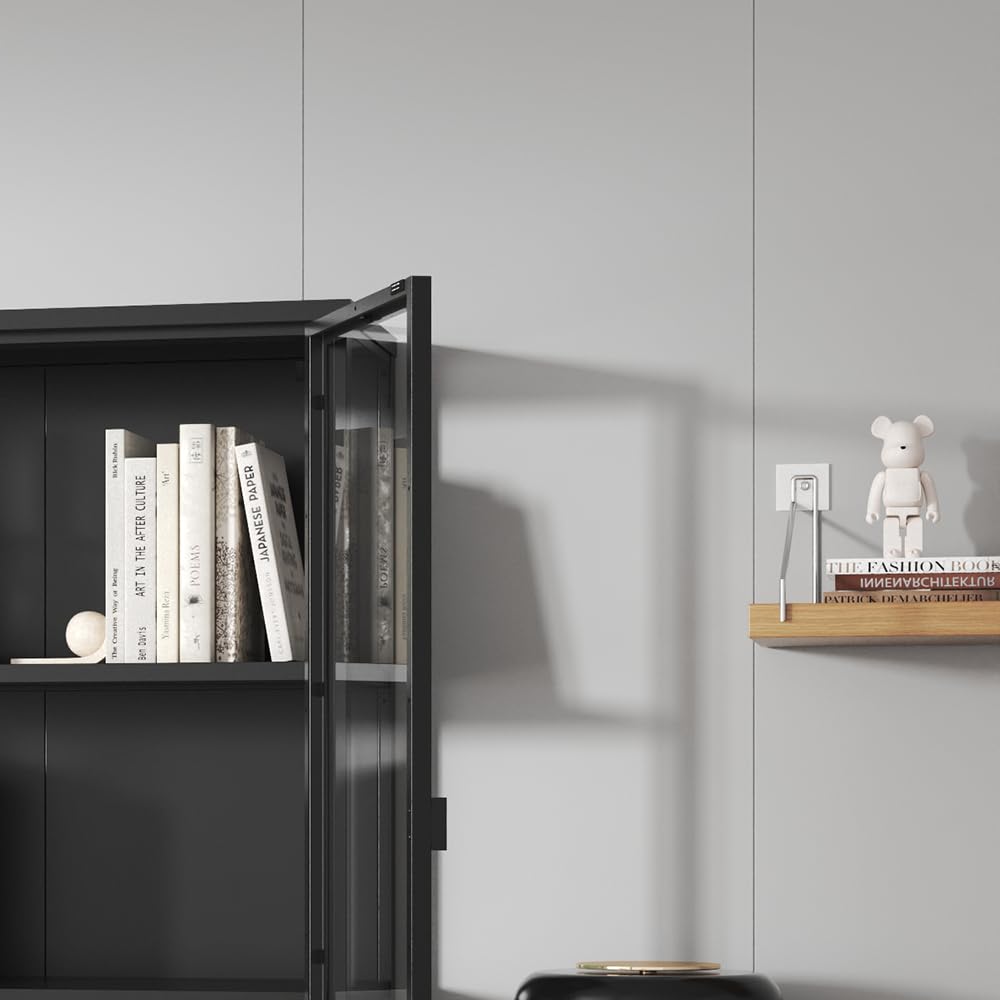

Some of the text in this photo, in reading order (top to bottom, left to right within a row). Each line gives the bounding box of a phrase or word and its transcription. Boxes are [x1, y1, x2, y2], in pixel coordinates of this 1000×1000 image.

[244, 465, 270, 563] JAPANESE PAPER
[135, 475, 146, 597] ART IN THE AFTER CULTURE
[190, 544, 200, 586] POEMS
[826, 562, 862, 573] THE
[868, 561, 945, 573] FASHION
[825, 595, 877, 603] PATRICK
[138, 626, 146, 660] Ben Davis
